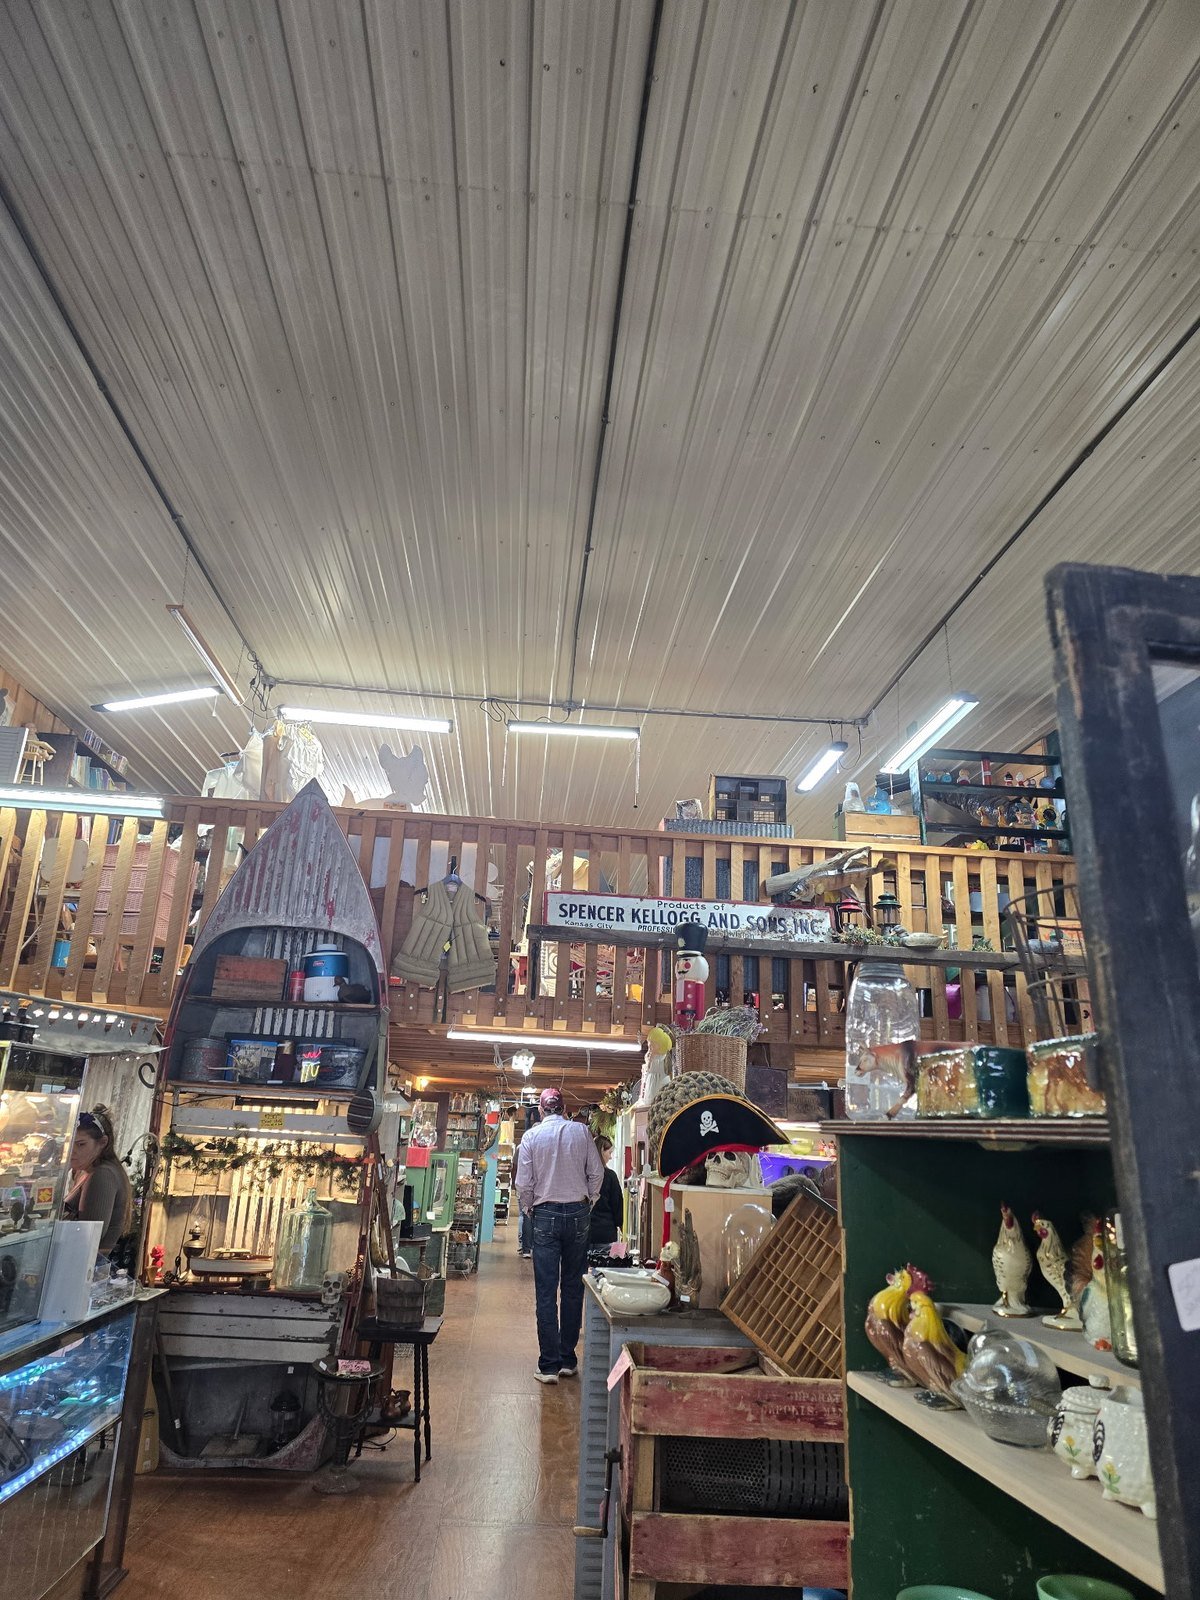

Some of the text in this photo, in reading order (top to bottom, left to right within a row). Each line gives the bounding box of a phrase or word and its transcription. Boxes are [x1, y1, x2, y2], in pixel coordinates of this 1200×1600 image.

[657, 900, 725, 911] Products of
[559, 903, 625, 922] SPENCER
[631, 908, 701, 925] KELLOGG
[707, 912, 740, 930] AND
[564, 920, 613, 930] Kansas City
